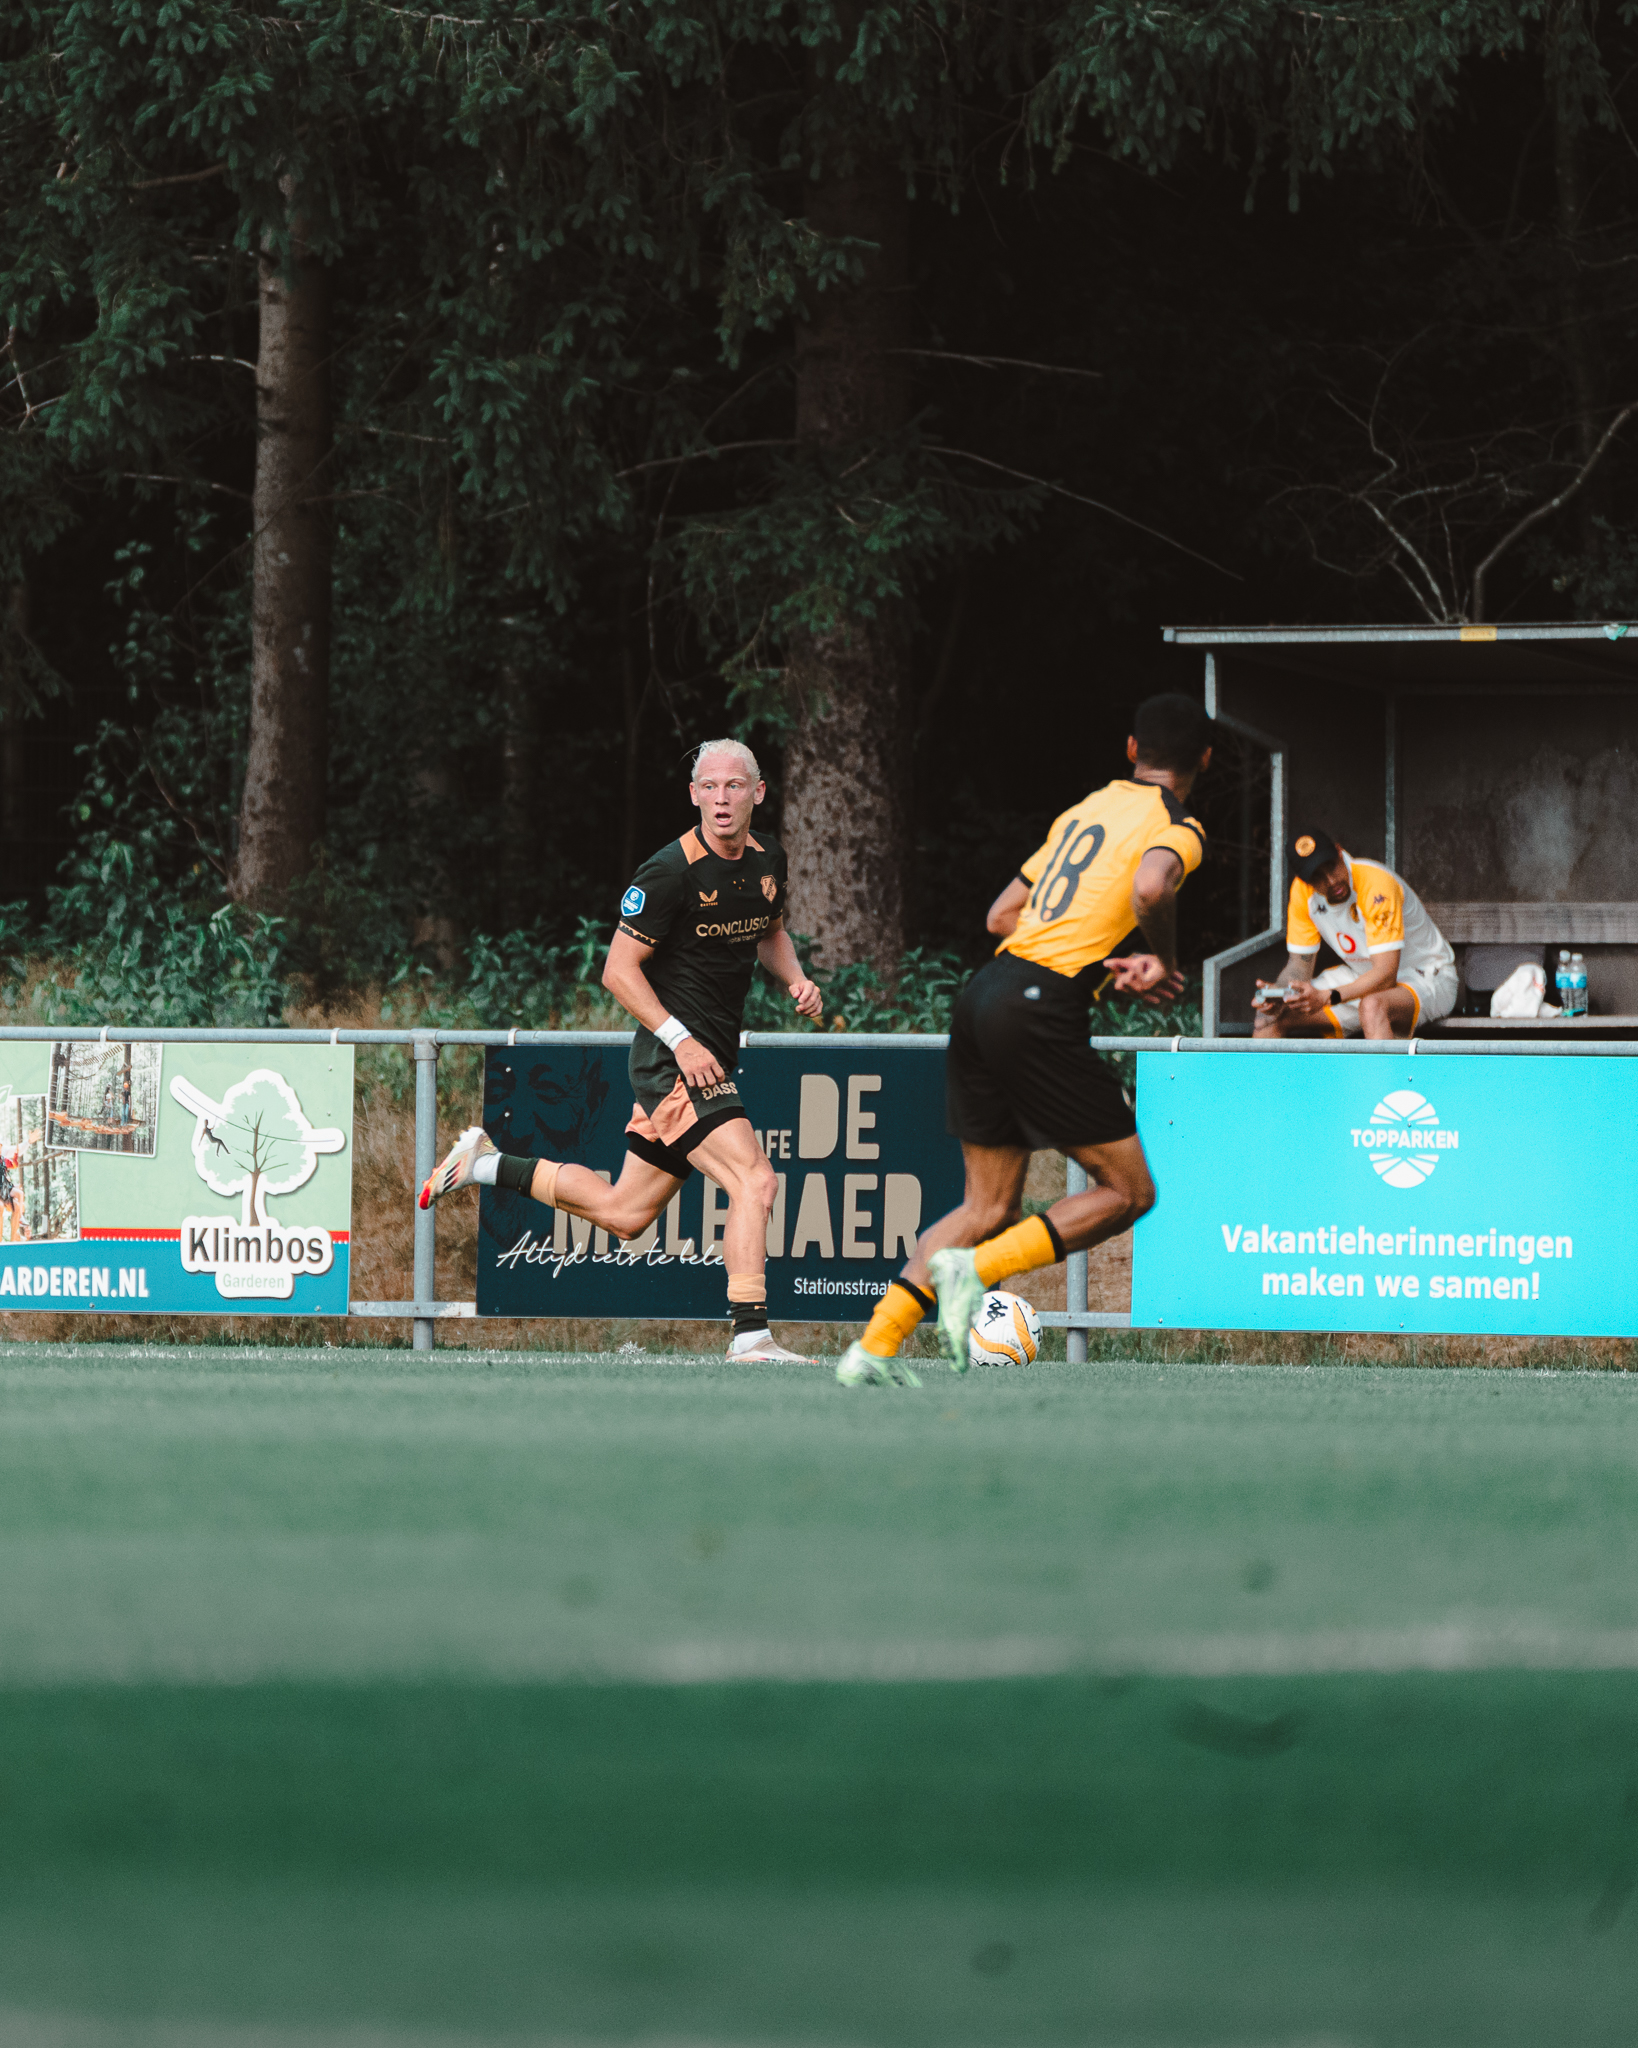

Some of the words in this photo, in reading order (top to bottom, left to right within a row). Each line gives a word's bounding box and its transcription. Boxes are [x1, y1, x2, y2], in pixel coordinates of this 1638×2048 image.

[1031, 819, 1106, 922] 18
[695, 915, 770, 938] CONCLUSIO
[799, 1074, 881, 1160] DE
[1351, 1129, 1459, 1149] TOPPARKEN
[188, 1227, 325, 1264] Klimbos
[496, 1230, 588, 1279] Altijd
[592, 1240, 642, 1267] iets
[644, 1237, 675, 1267] te
[1221, 1224, 1573, 1265] Vakantieherinneringen
[0, 1266, 149, 1298] ARDEREN.NL
[222, 1273, 285, 1290] Garderen
[1263, 1267, 1365, 1297] maken
[1375, 1274, 1420, 1298] we
[1429, 1272, 1540, 1300] samen!
